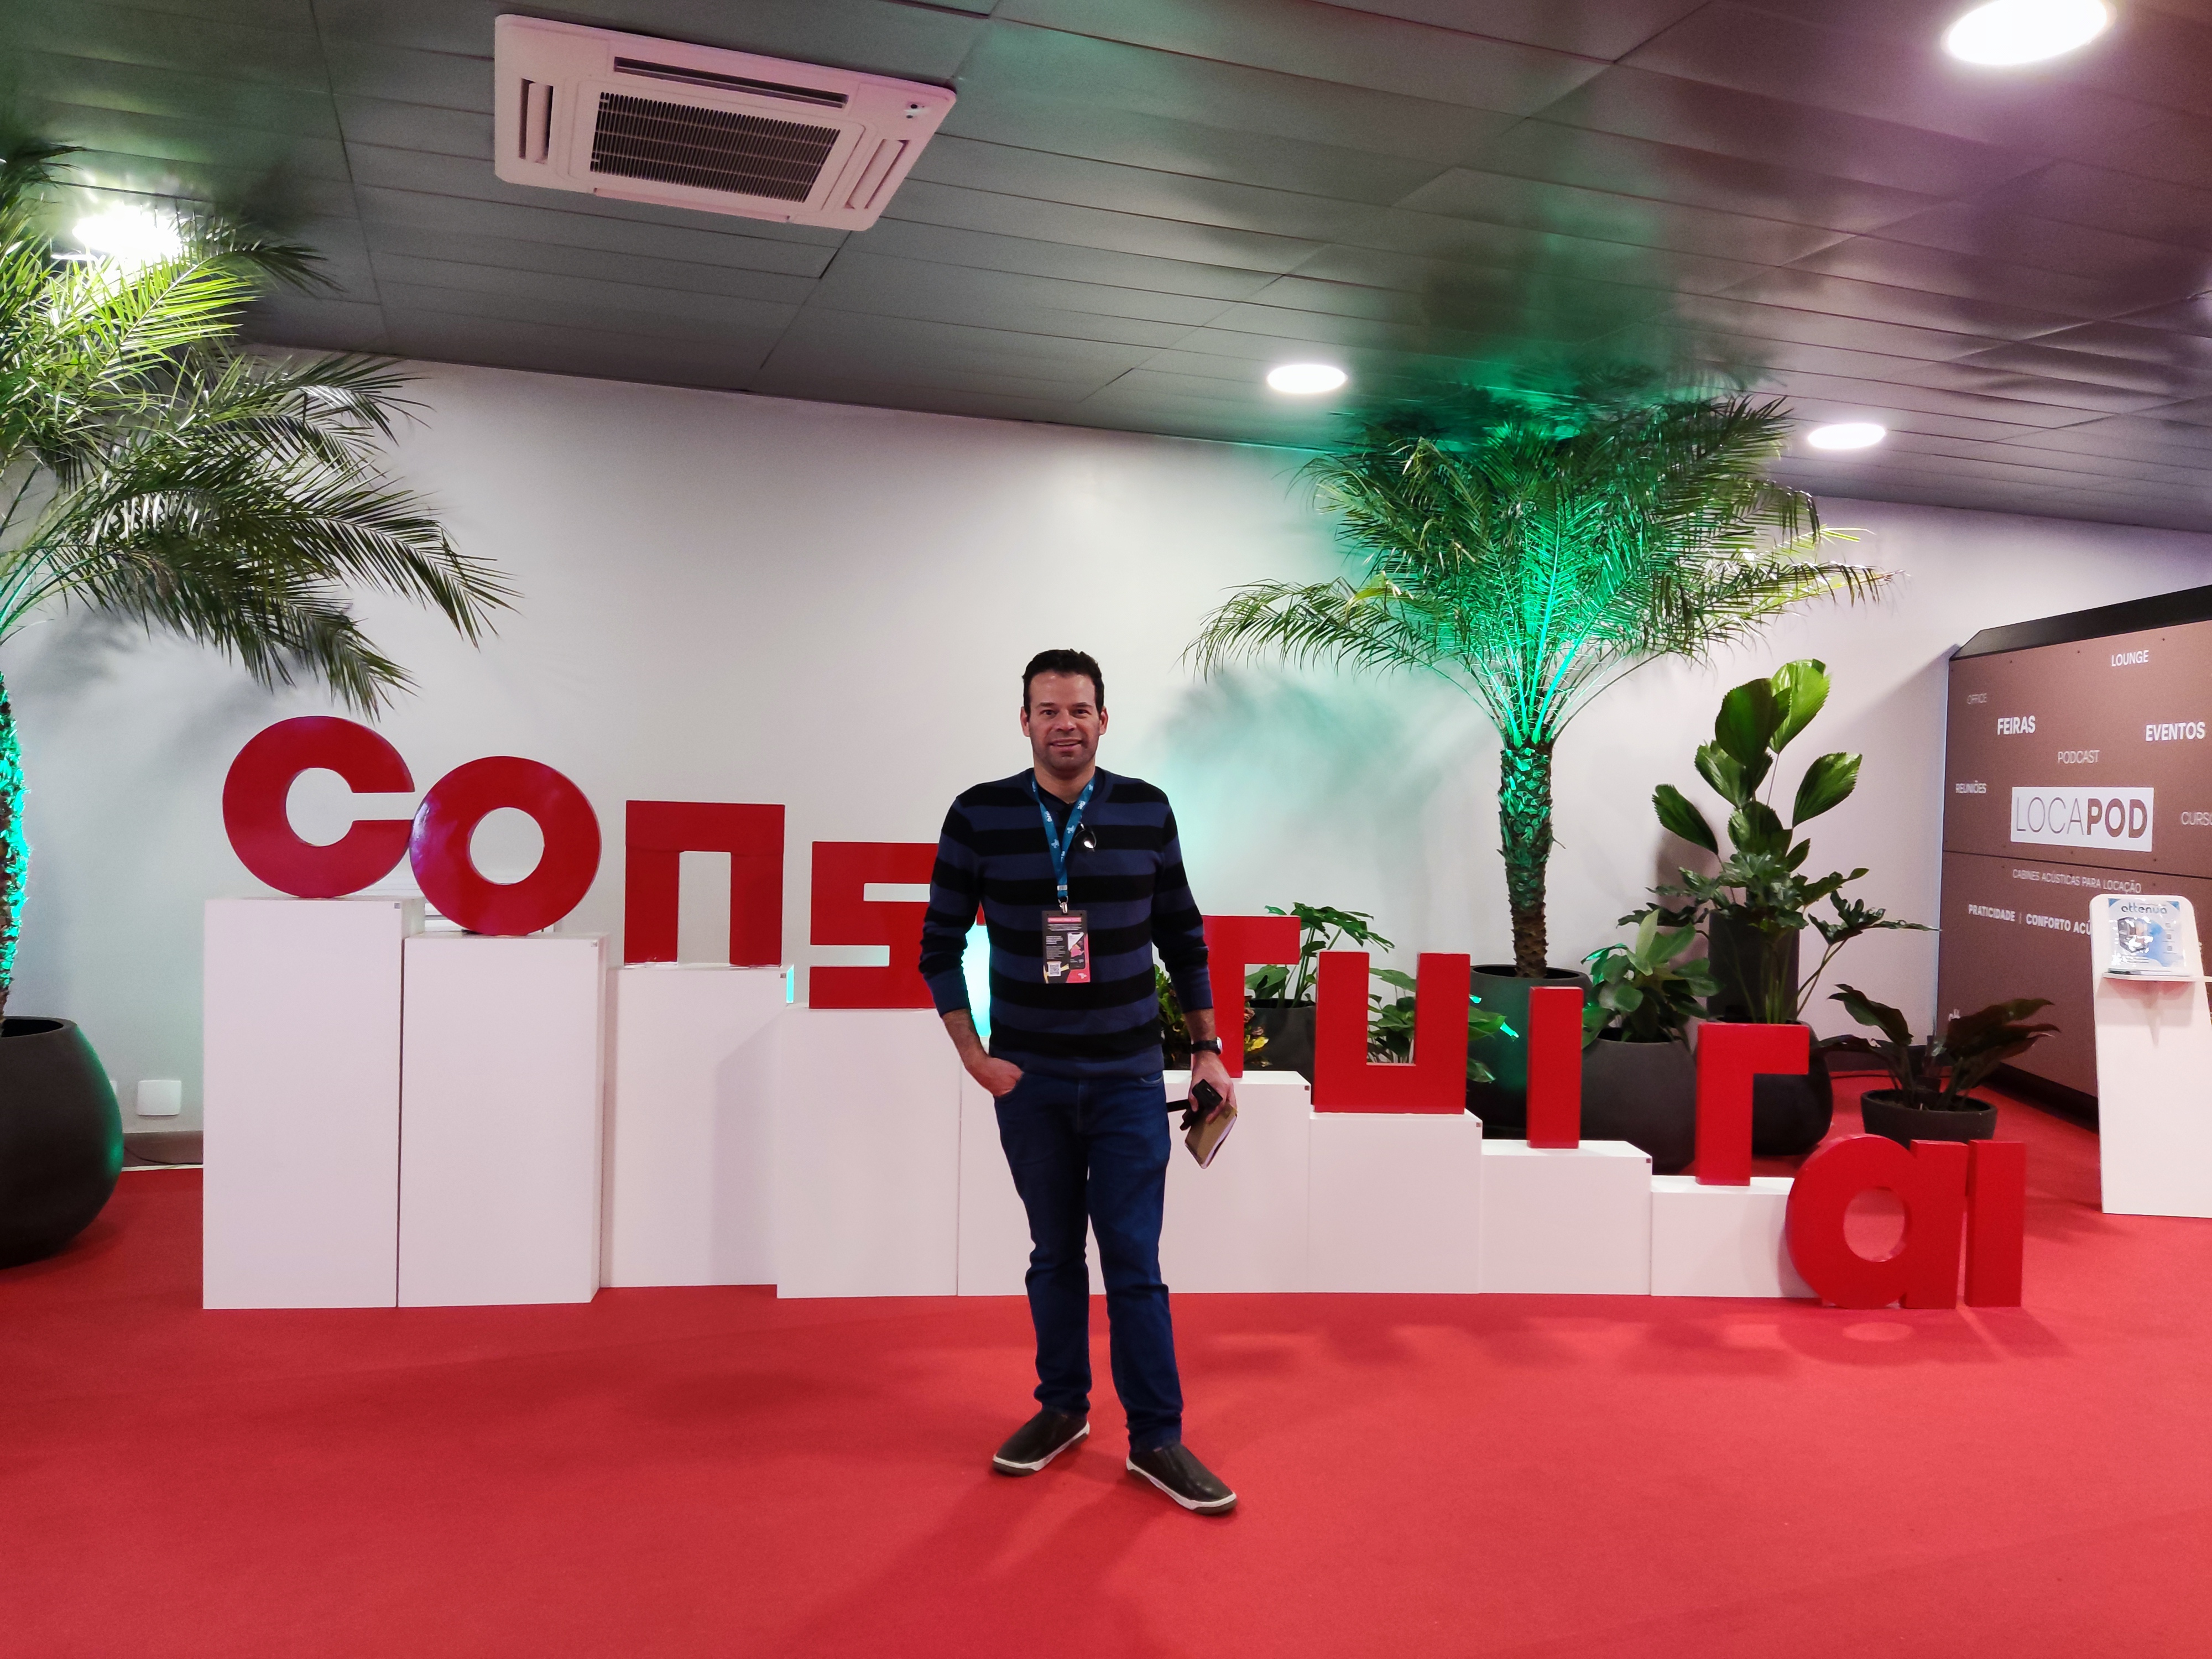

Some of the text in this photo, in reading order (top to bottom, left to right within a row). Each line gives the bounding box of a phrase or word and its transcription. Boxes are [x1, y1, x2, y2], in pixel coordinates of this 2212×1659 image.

[2111, 650, 2149, 666] LOUNGE
[1997, 716, 2036, 735] FEIRAS
[2146, 722, 2205, 742] EVENTOS
[2058, 750, 2100, 764] PODCAST
[1955, 780, 1986, 793] REUNIÕES
[2016, 797, 2147, 838] LOCAPOD
[2181, 811, 2212, 826] CURS
[2013, 869, 2141, 894] CABINES ACÚSTICAS PARA LOCAÇÃO
[1969, 904, 2015, 922] PRATICIDADE
[2026, 914, 2071, 932] CONFORTO
